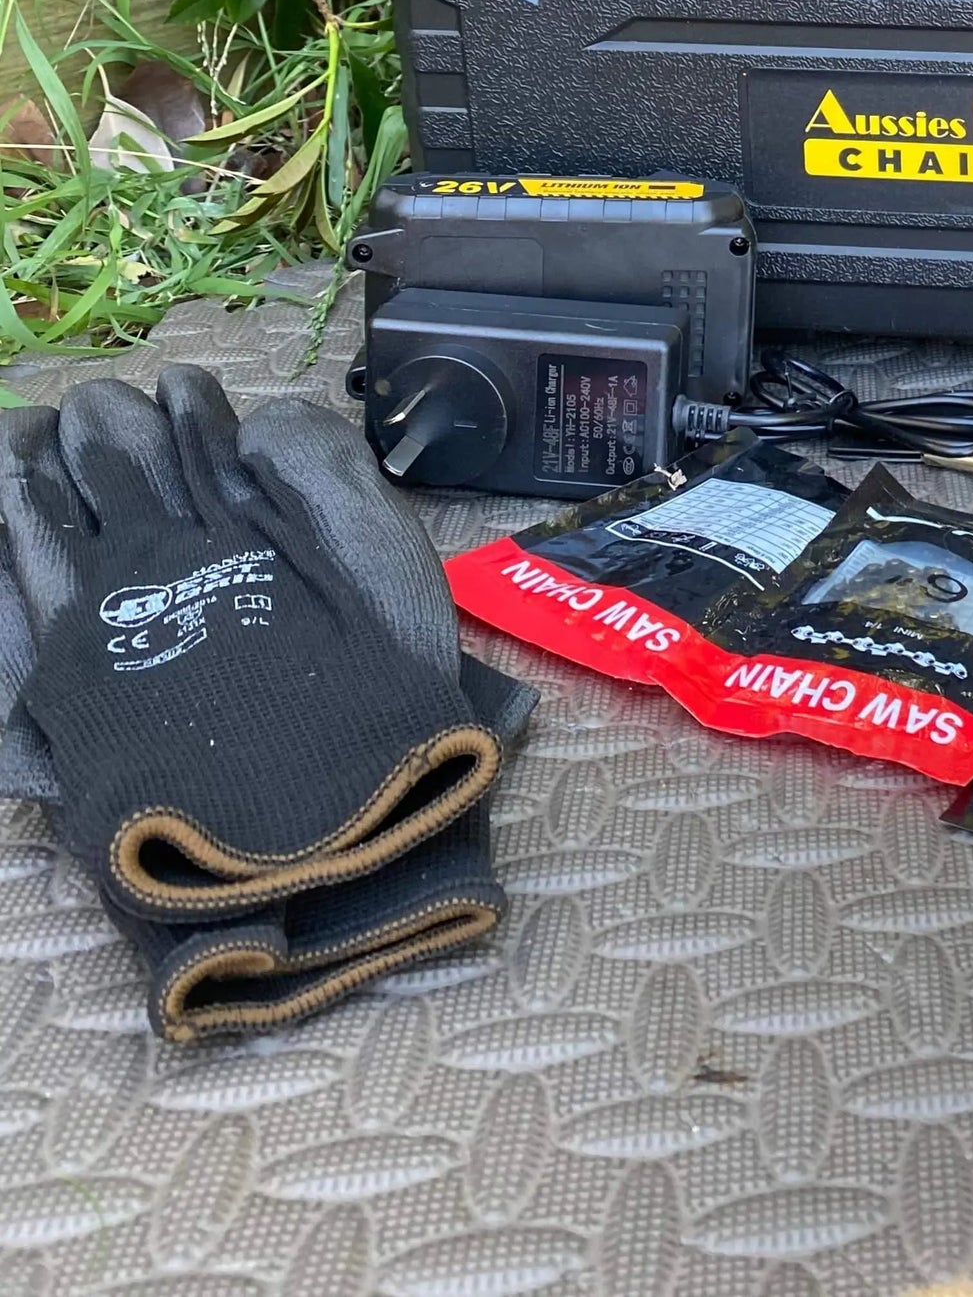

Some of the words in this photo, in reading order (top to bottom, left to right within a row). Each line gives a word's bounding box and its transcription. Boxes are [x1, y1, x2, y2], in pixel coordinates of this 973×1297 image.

[805, 89, 967, 137] Aussies
[431, 180, 517, 194] 26V
[540, 182, 609, 190] LITHIUM
[545, 364, 559, 394] Charger
[544, 397, 556, 424] Li-ion
[593, 397, 604, 439] 50/60Hz
[501, 560, 604, 611] CHAIN
[593, 600, 681, 652] SAW
[724, 662, 857, 712] CHAIN
[858, 692, 964, 745] SAW
